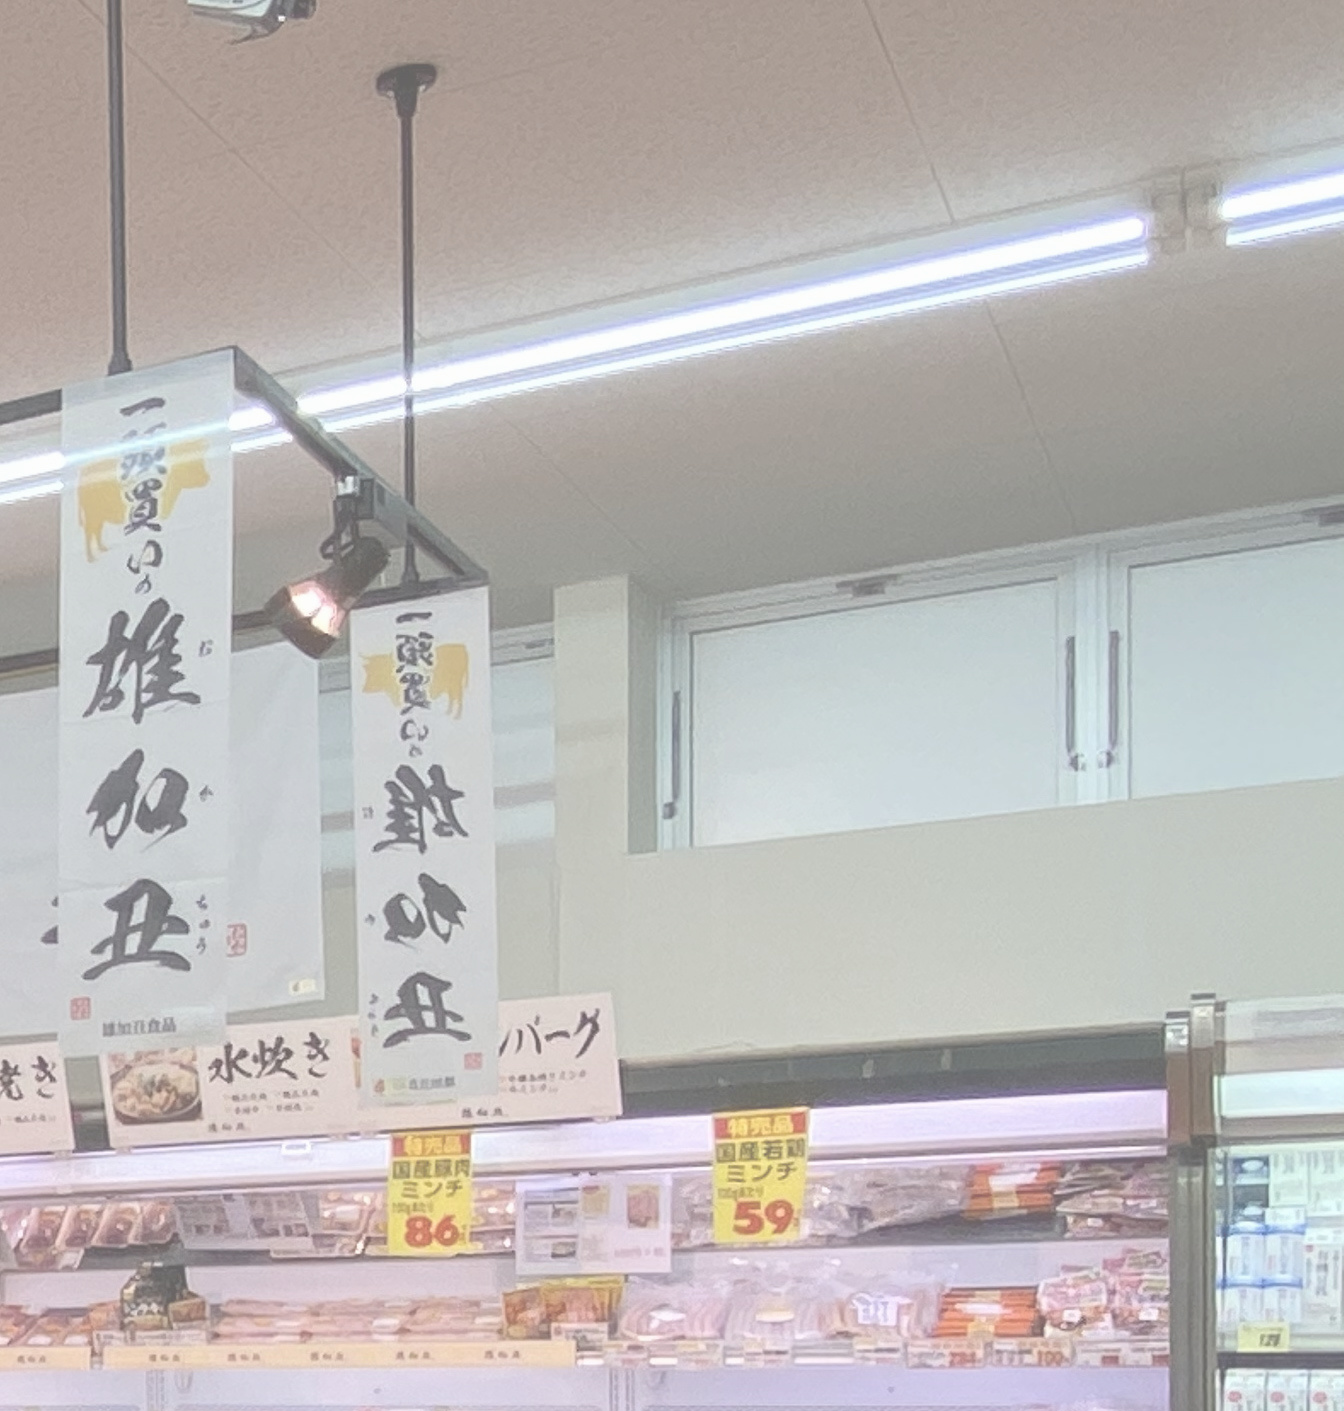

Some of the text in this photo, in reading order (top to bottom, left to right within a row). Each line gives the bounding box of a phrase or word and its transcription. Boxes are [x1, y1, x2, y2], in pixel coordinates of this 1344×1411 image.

[207, 1030, 330, 1085] 水炊き
[725, 1110, 793, 1136] 特売品
[402, 1133, 464, 1156] 特売品
[715, 1138, 806, 1164] 国産若鶏
[392, 1157, 471, 1180] 国産豚肉
[724, 1161, 798, 1182] ミンチ
[400, 1179, 464, 1199] ミンチ
[403, 1213, 459, 1248] 86
[731, 1199, 794, 1237] 59
